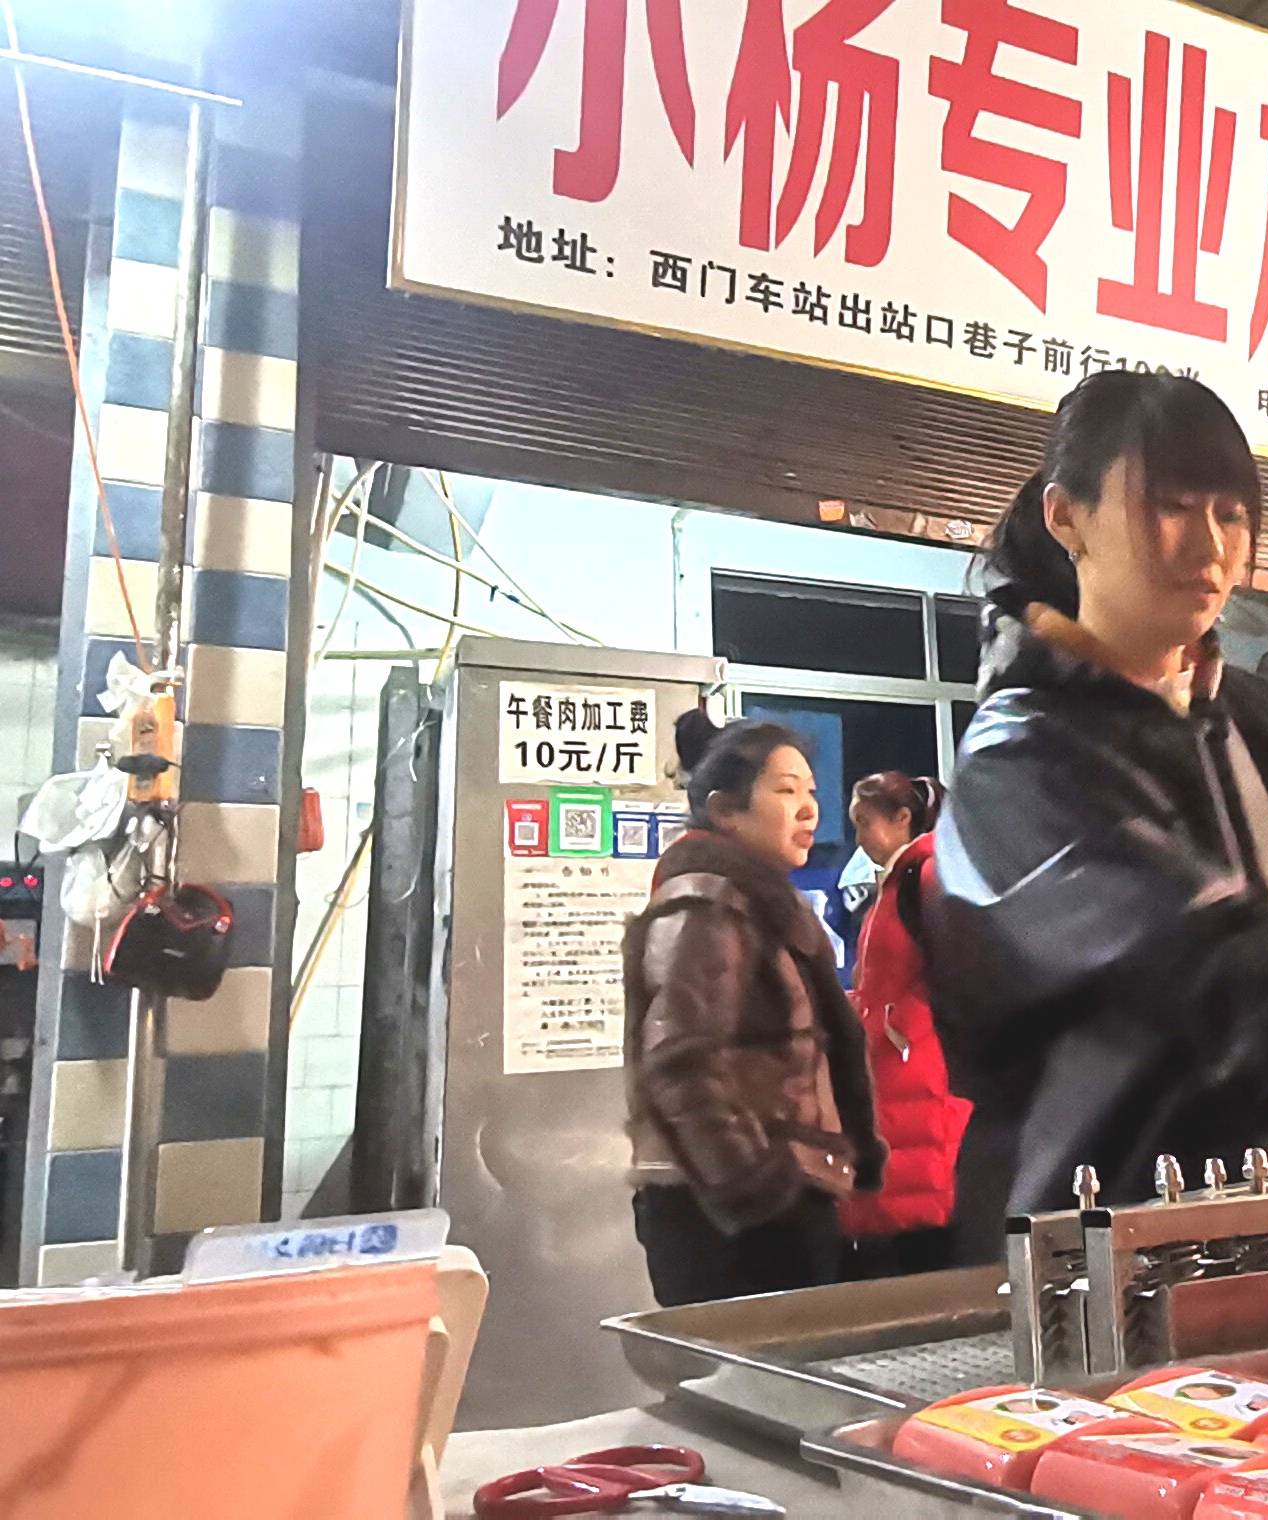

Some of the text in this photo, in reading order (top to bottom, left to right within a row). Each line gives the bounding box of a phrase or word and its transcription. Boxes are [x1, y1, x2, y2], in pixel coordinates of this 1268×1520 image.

[506, 692, 649, 735] 午餐肉加工费
[514, 740, 644, 774] 10元/斤
